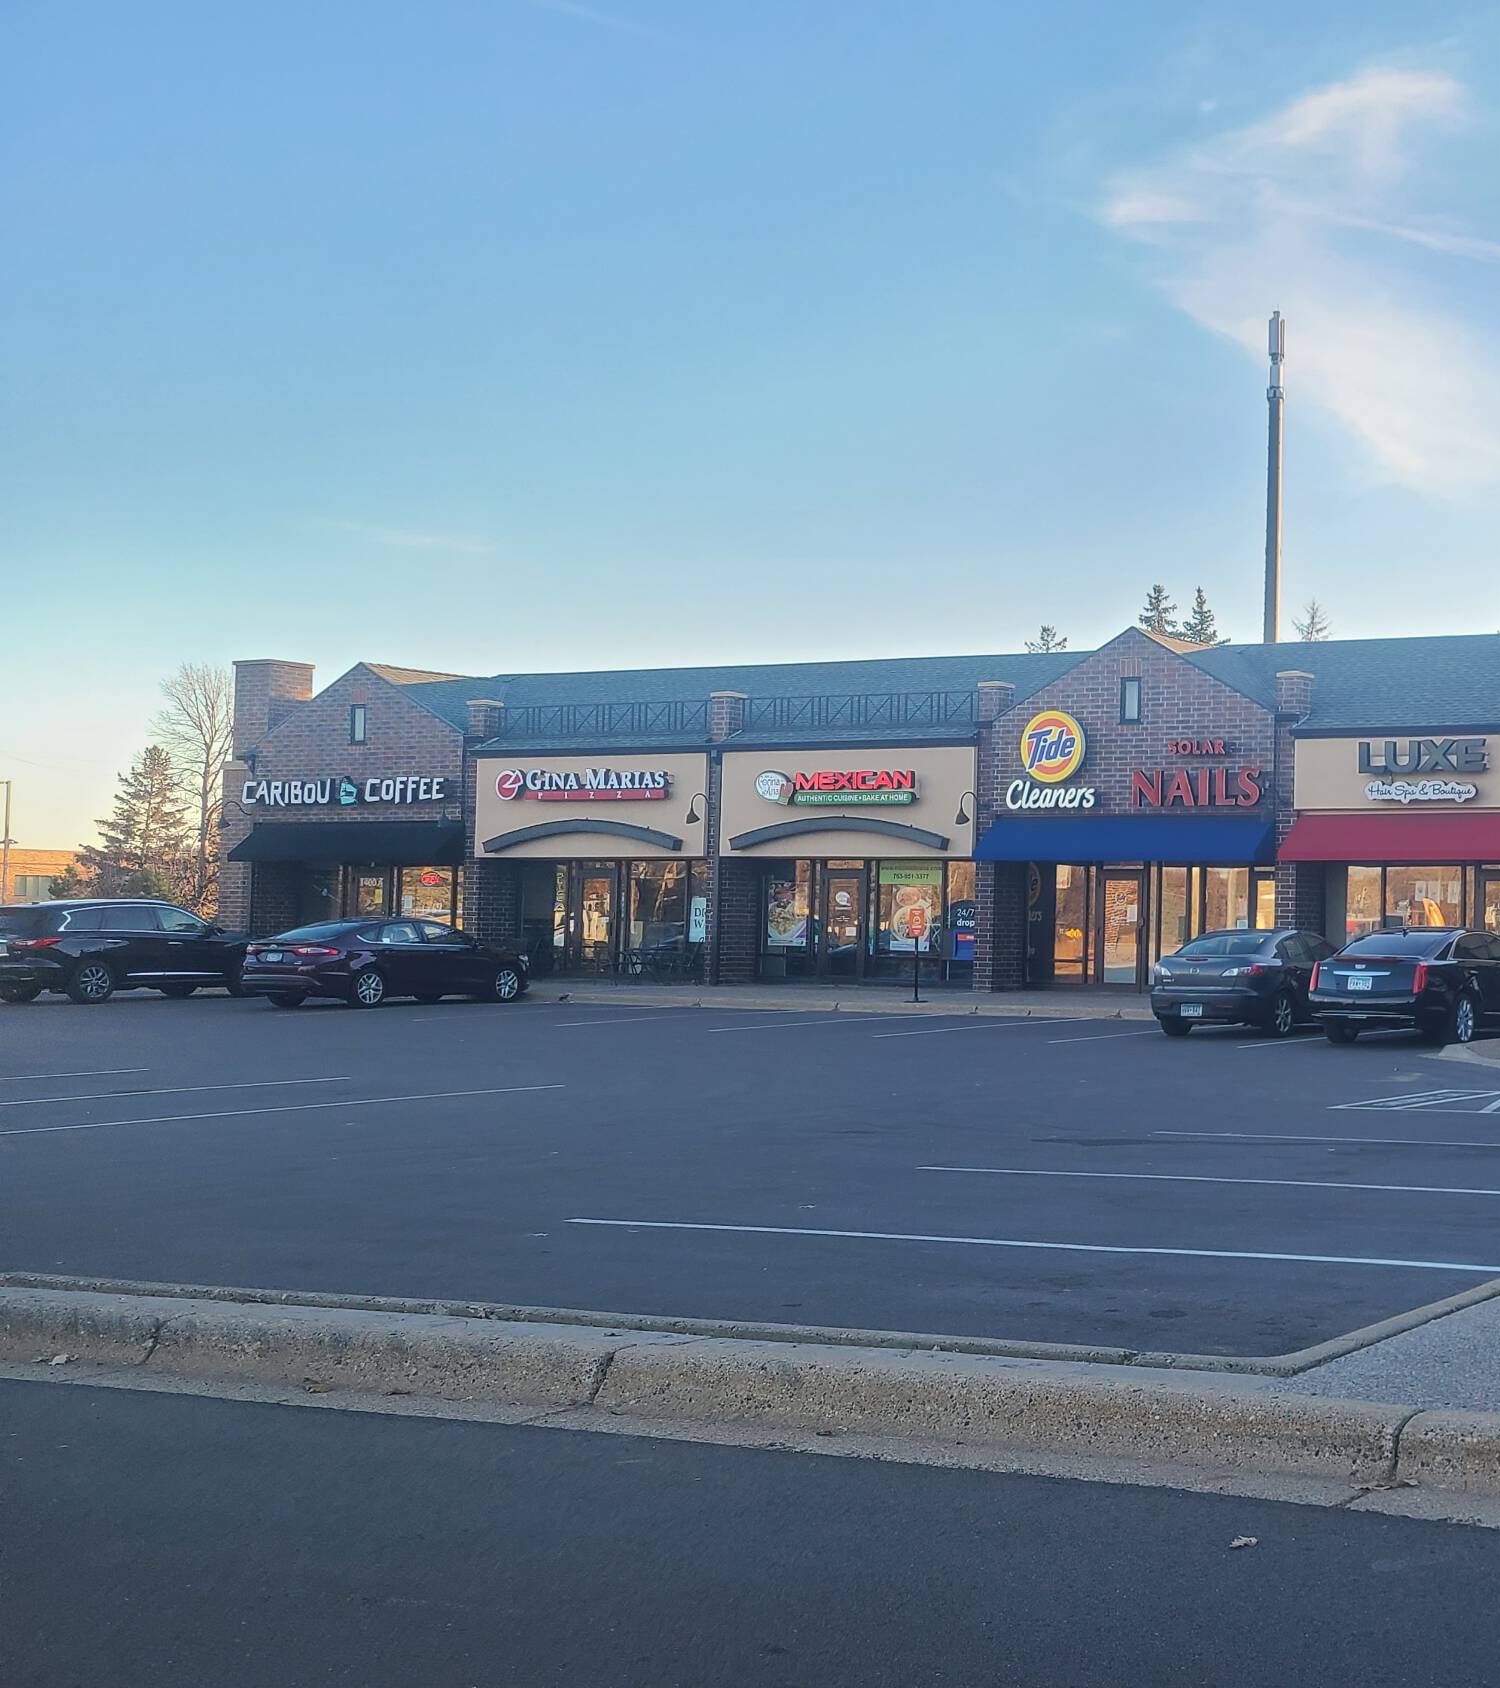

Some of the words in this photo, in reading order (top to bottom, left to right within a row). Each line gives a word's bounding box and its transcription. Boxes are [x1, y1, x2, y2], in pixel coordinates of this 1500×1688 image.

[1026, 726, 1076, 772] Tide
[1167, 737, 1226, 755] SOLAR
[1358, 738, 1487, 773] LUXE
[795, 771, 912, 790] MEXICAN
[1131, 767, 1261, 806] NAILS
[241, 778, 331, 807] CARIBOU
[364, 776, 445, 804] COFFEE
[537, 791, 651, 799] PIZZA
[797, 794, 833, 802] AUTHENTIC
[890, 793, 909, 801] HOME
[1005, 780, 1095, 810] Cleaners
[1368, 784, 1392, 796] Hair
[1394, 784, 1417, 799] Spa
[1418, 784, 1429, 796] &
[1429, 784, 1473, 799] Boutique
[957, 908, 975, 917] 24/7
[957, 918, 975, 927] drop
